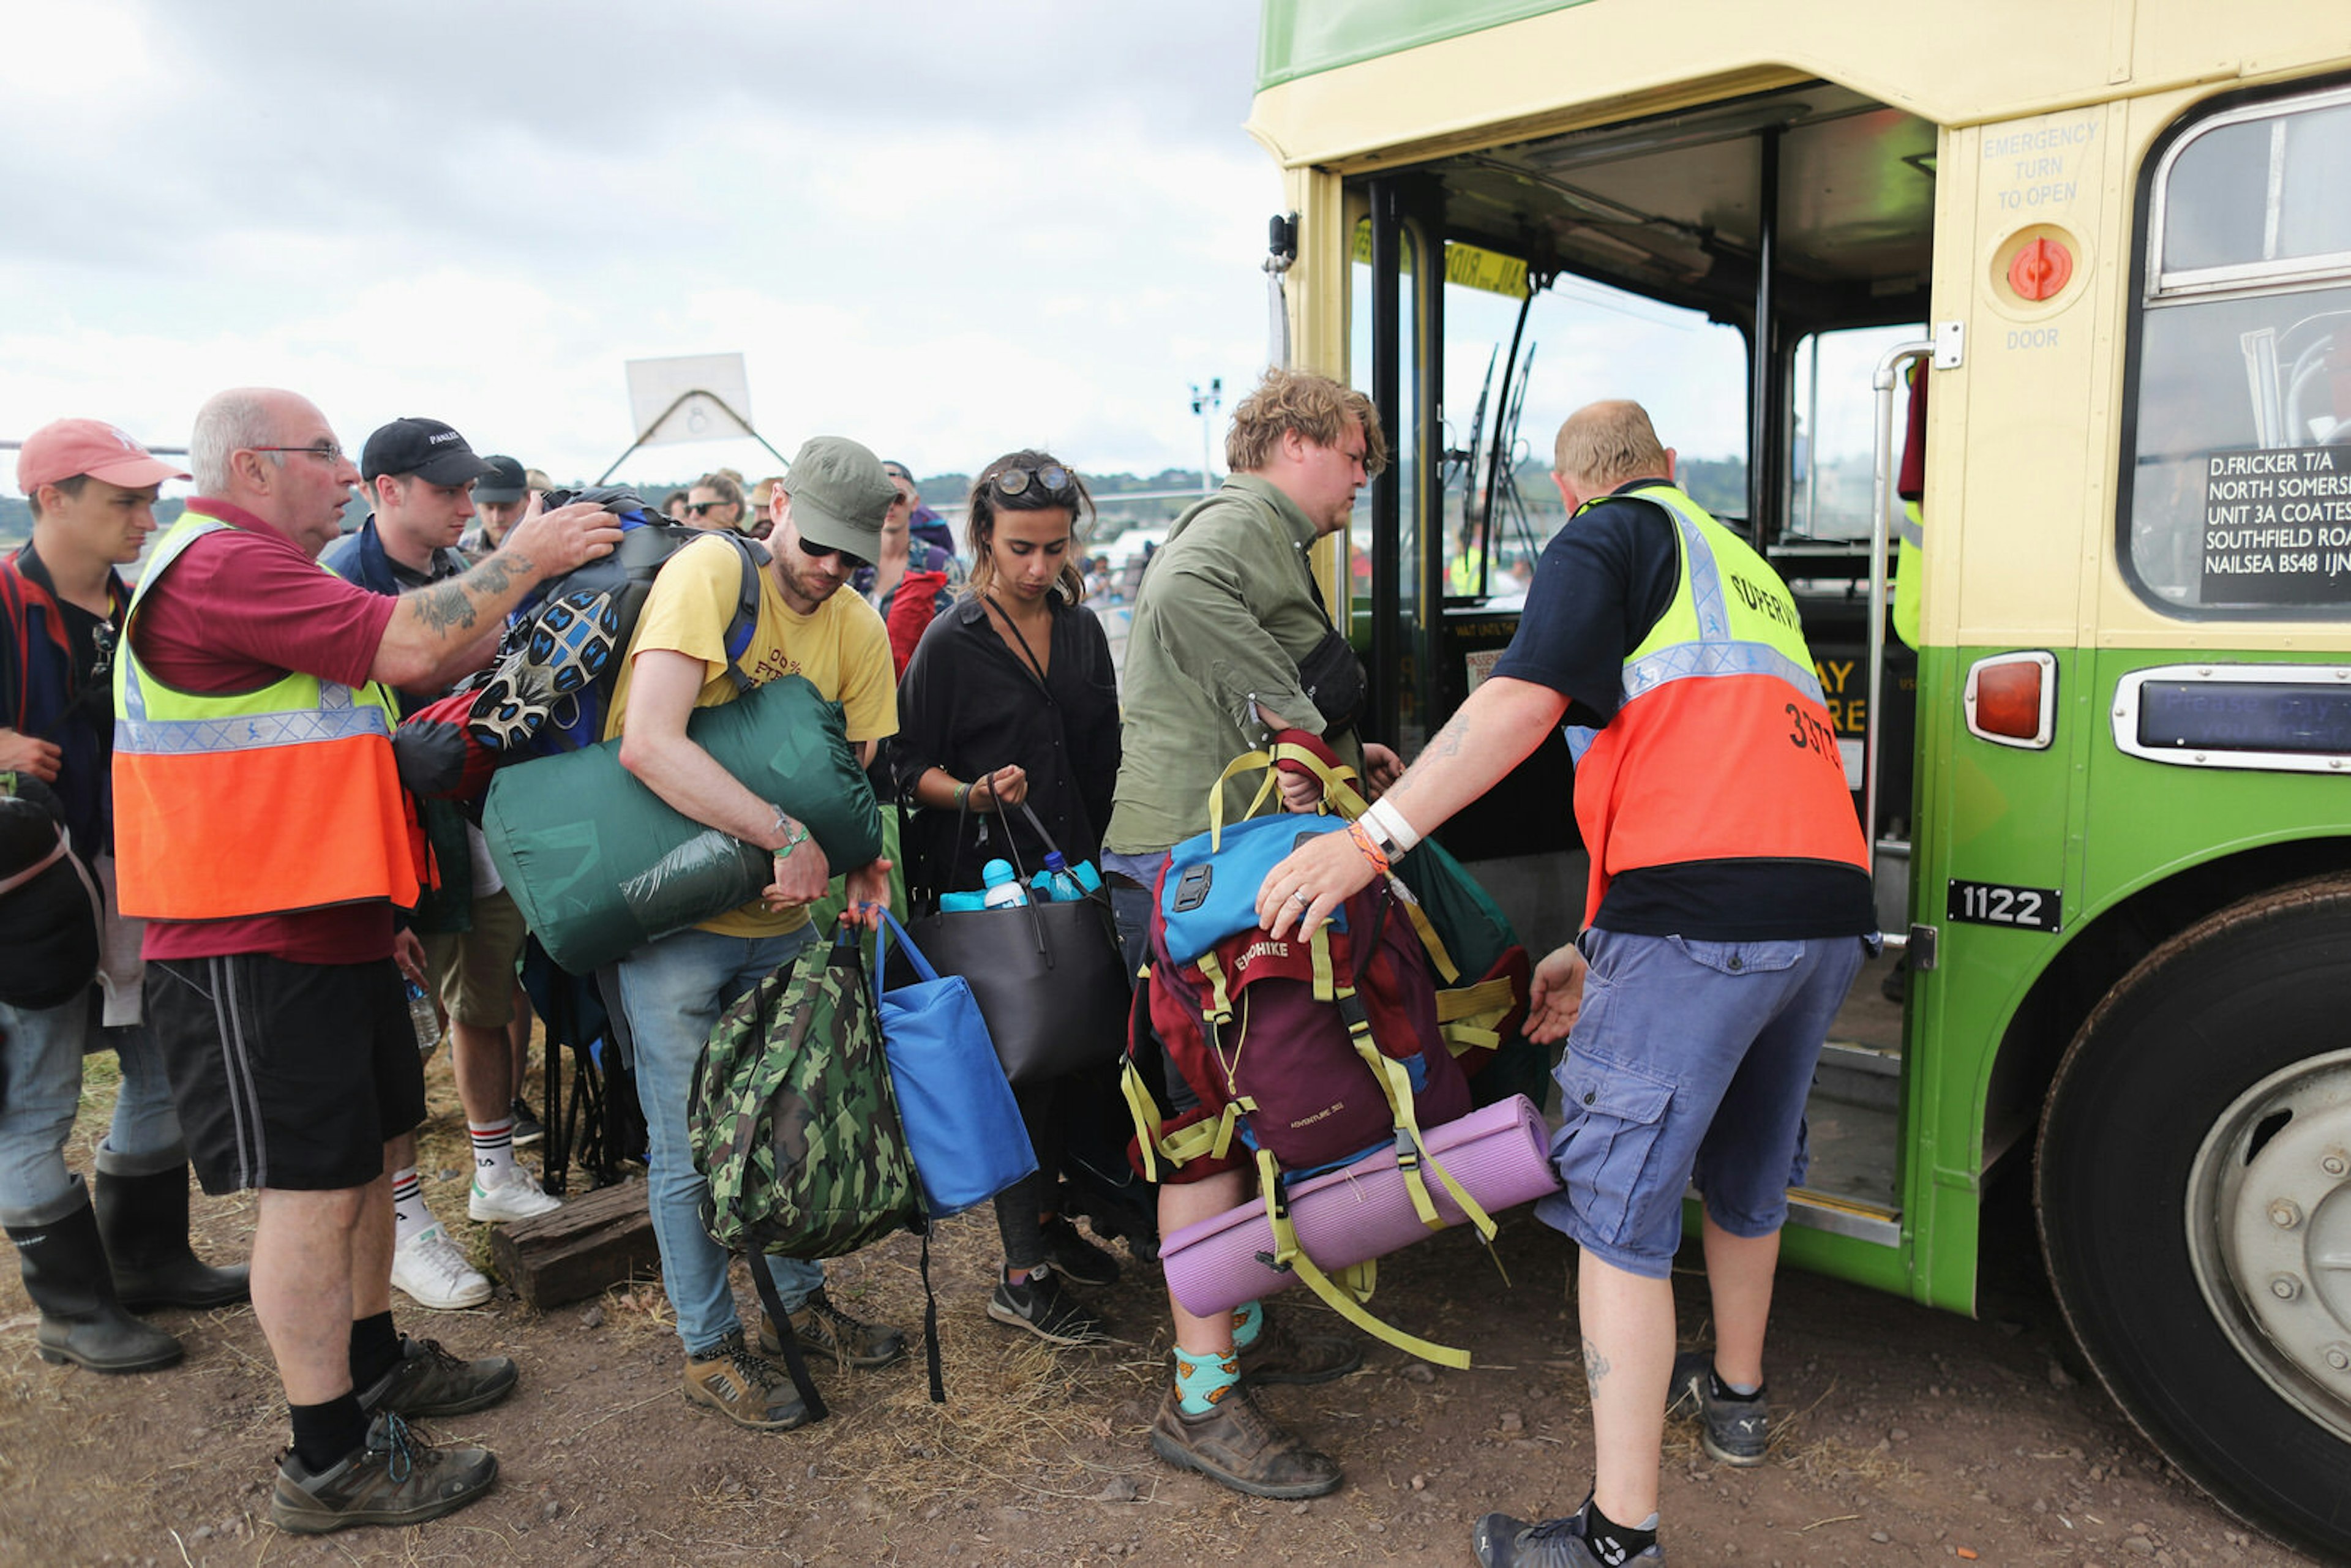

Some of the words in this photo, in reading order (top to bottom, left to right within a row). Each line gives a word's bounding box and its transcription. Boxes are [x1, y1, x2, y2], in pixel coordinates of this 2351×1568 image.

[1984, 121, 2099, 159] EMERGENCY
[2015, 156, 2063, 180] TURN
[1998, 189, 2021, 211] TO
[2026, 181, 2077, 206] OPEN
[2007, 328, 2058, 350] DOOR
[2210, 454, 2298, 476] D.FRICKER
[2303, 451, 2334, 471] T/A
[2209, 479, 2273, 501] NORTH
[2207, 505, 2251, 525] UNIT
[2254, 505, 2277, 524] 3A
[2206, 528, 2313, 550] SOUTHFIELD
[2205, 553, 2274, 574] NAILSEA
[2278, 553, 2319, 573] BS48
[1963, 885, 2042, 926] 1122
